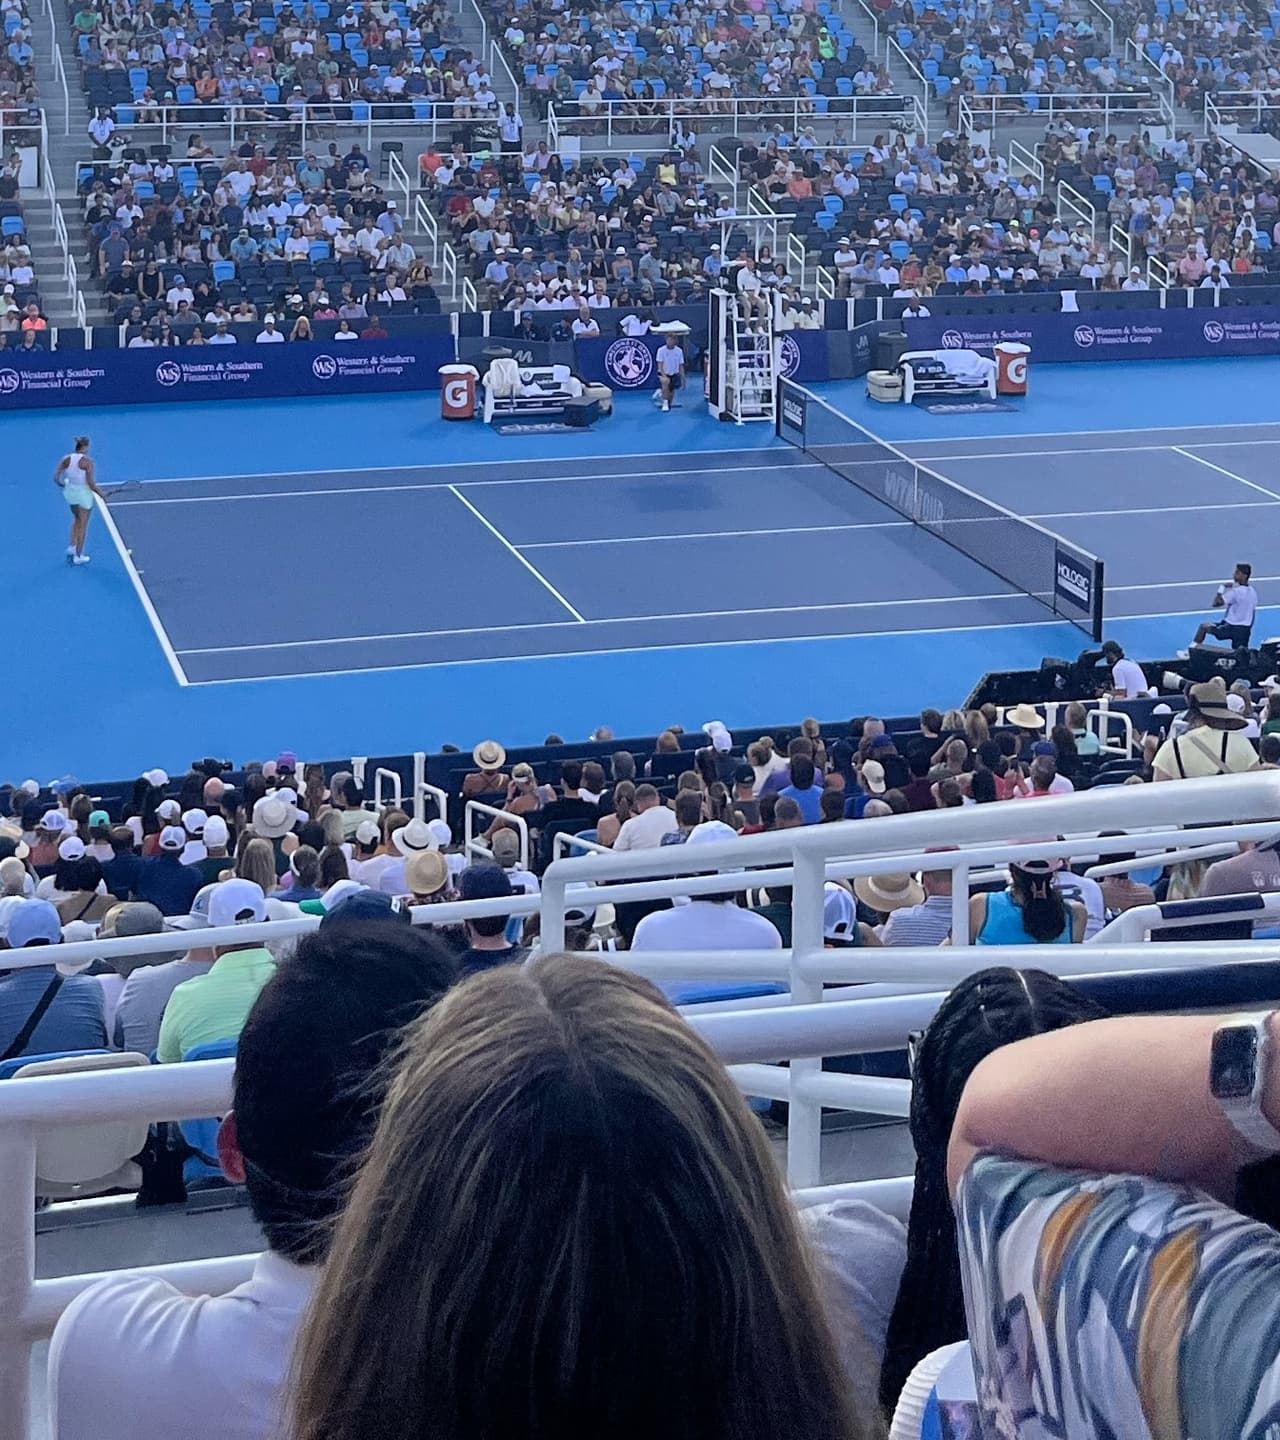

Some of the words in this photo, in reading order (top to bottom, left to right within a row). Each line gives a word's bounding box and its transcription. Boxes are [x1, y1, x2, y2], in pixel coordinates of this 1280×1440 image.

[370, 356, 378, 364] &
[181, 363, 214, 372] Western
[216, 362, 224, 371] &
[226, 361, 263, 370] Southern
[1007, 357, 1026, 384] G
[20, 370, 55, 379] Western
[56, 369, 64, 377] &
[67, 368, 105, 377] Southern
[223, 372, 250, 382] Group
[22, 379, 61, 389] Financial
[63, 379, 91, 389] Group
[445, 380, 468, 408] G
[1058, 562, 1089, 591] HOLOGIC
